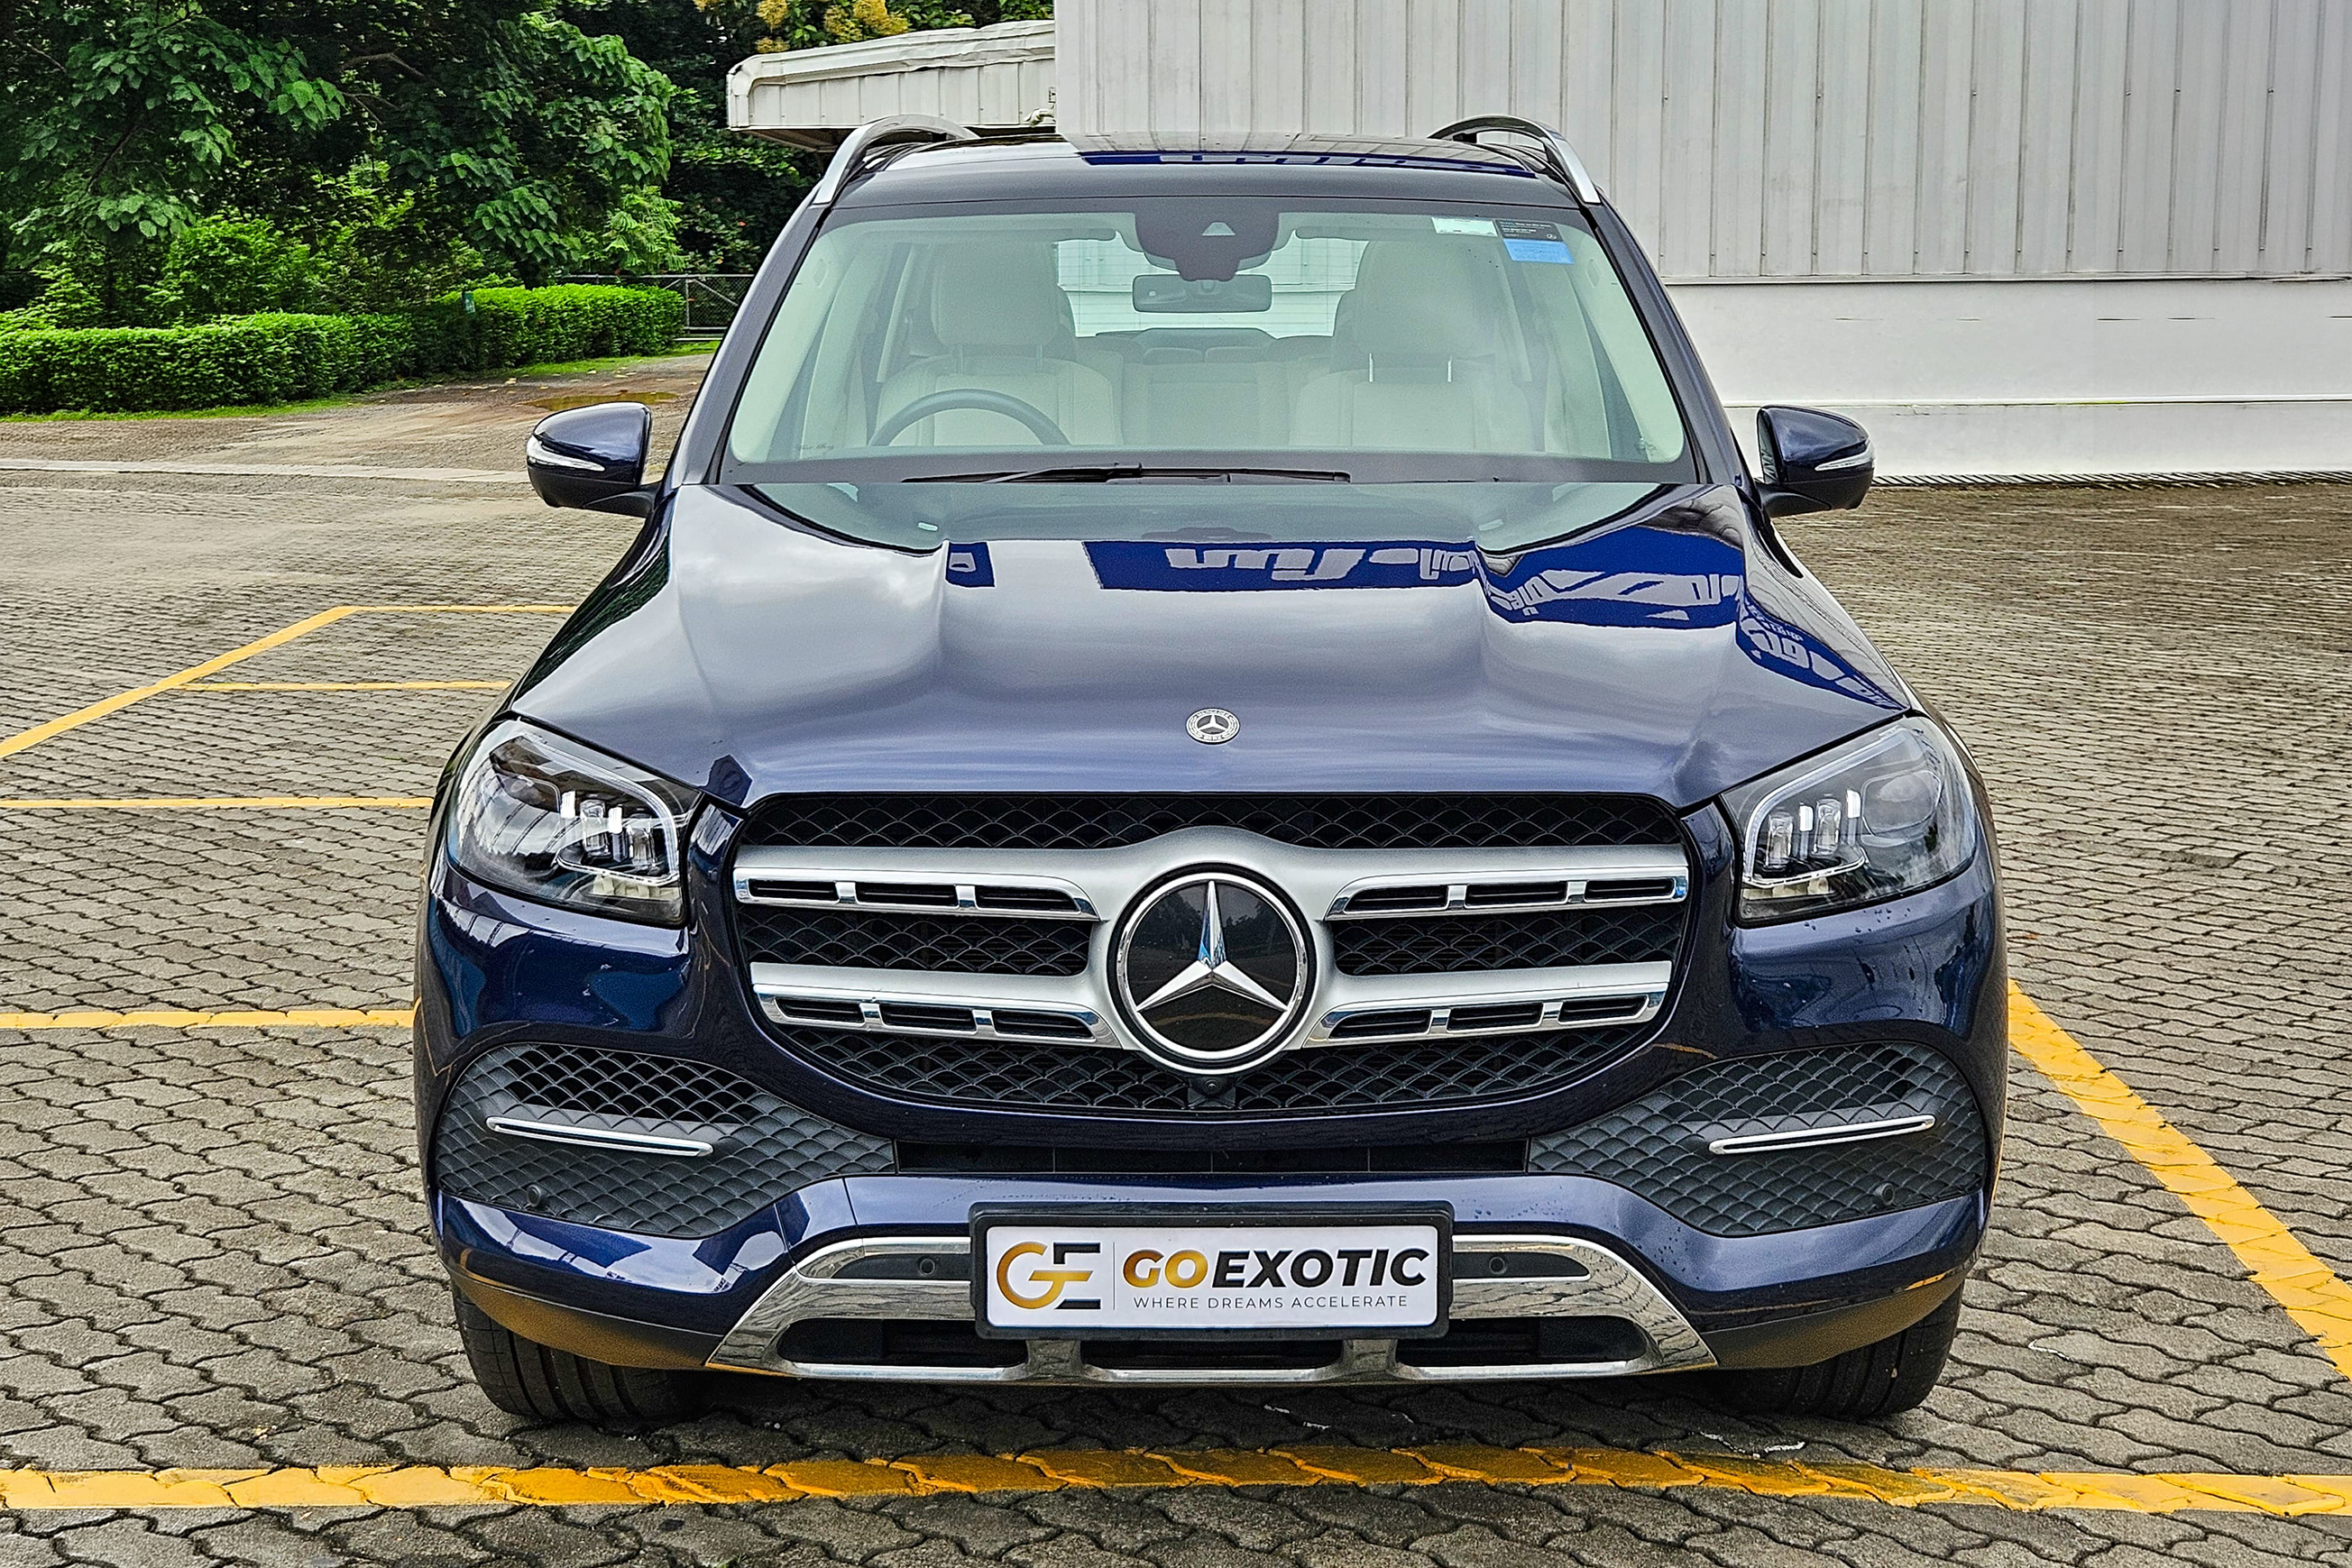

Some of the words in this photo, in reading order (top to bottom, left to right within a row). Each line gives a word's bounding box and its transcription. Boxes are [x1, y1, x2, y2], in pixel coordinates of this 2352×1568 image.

[1123, 1247, 1430, 1289] GOEXOTIC
[1133, 1297, 1199, 1309] WHERE
[1208, 1297, 1283, 1309] DREAMS
[1291, 1295, 1408, 1308] ACCELERATE
